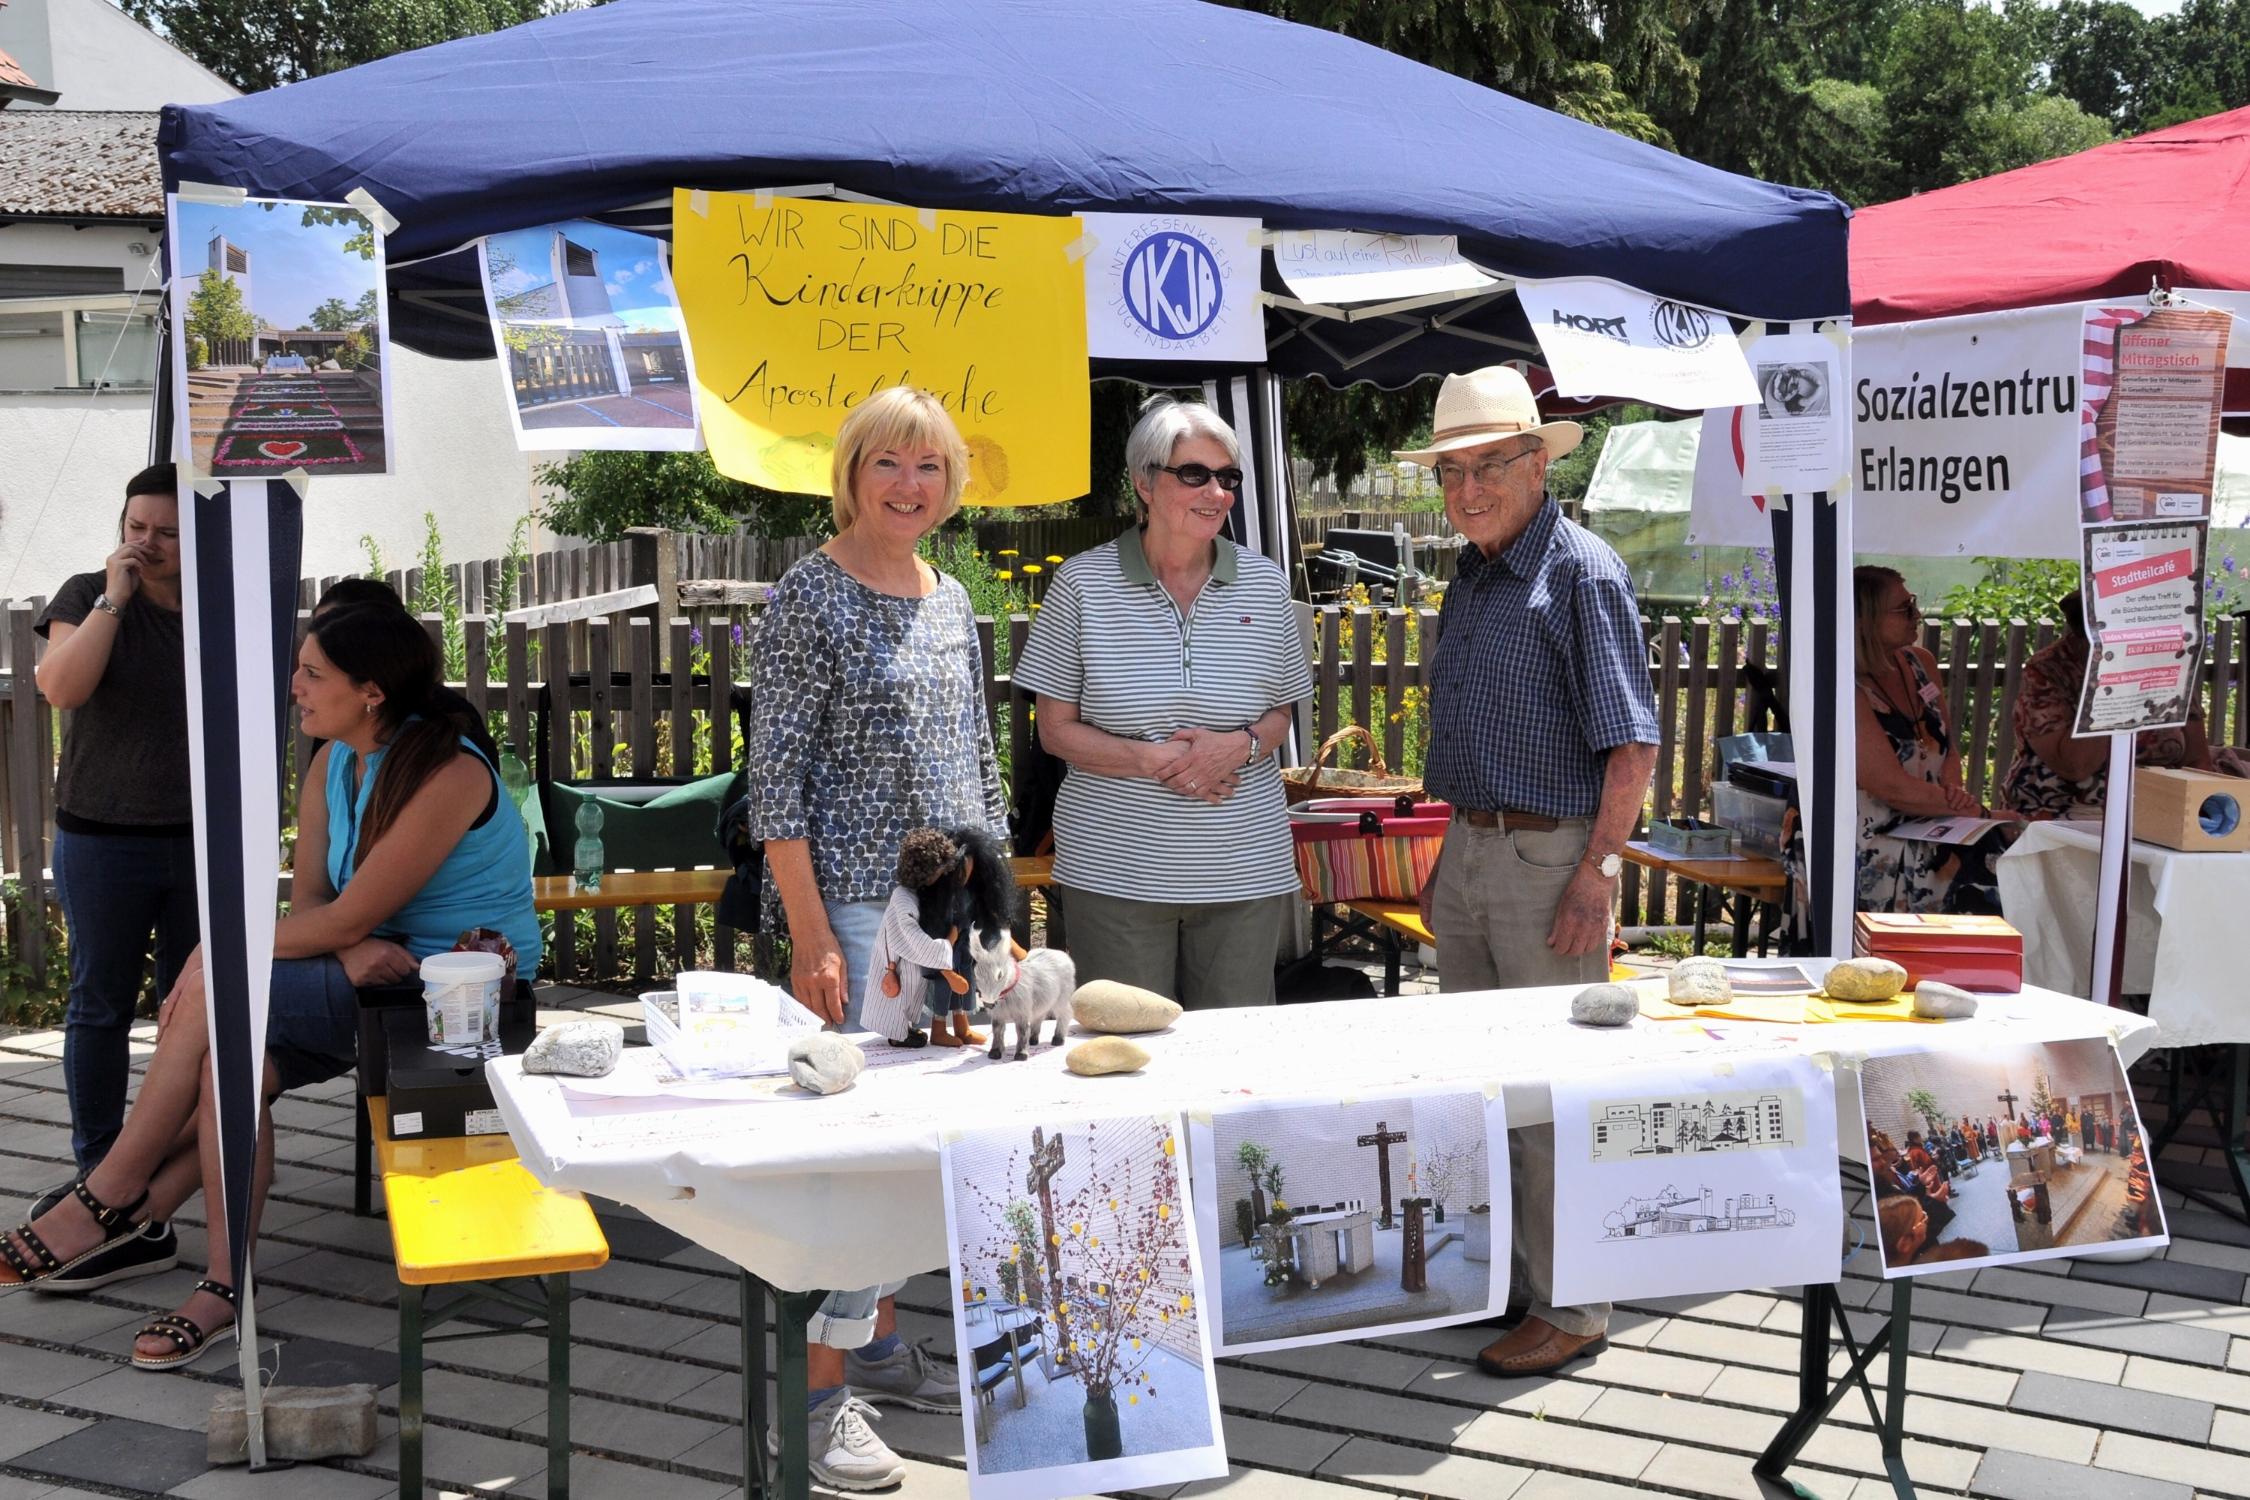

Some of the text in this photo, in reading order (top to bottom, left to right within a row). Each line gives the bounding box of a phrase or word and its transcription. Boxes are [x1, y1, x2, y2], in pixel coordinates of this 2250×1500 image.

[737, 203, 999, 260] WIR SIND DIE
[1108, 217, 1233, 280] INTERESSENKREIS
[1281, 231, 1322, 262] Lust
[1323, 238, 1351, 265] auf
[1352, 247, 1383, 262] eine
[727, 253, 1004, 328] Kinderkrippe
[817, 318, 911, 353] DER
[1108, 293, 1232, 351] JUGENDARBEIT
[1553, 308, 1628, 338] HORT
[2122, 334, 2171, 348] Offener
[2121, 353, 2199, 368] Mittagstisch
[723, 359, 1005, 423] Apostelche
[1860, 446, 2010, 504] Erlangen
[2111, 560, 2176, 588] Stadtteilcafé
